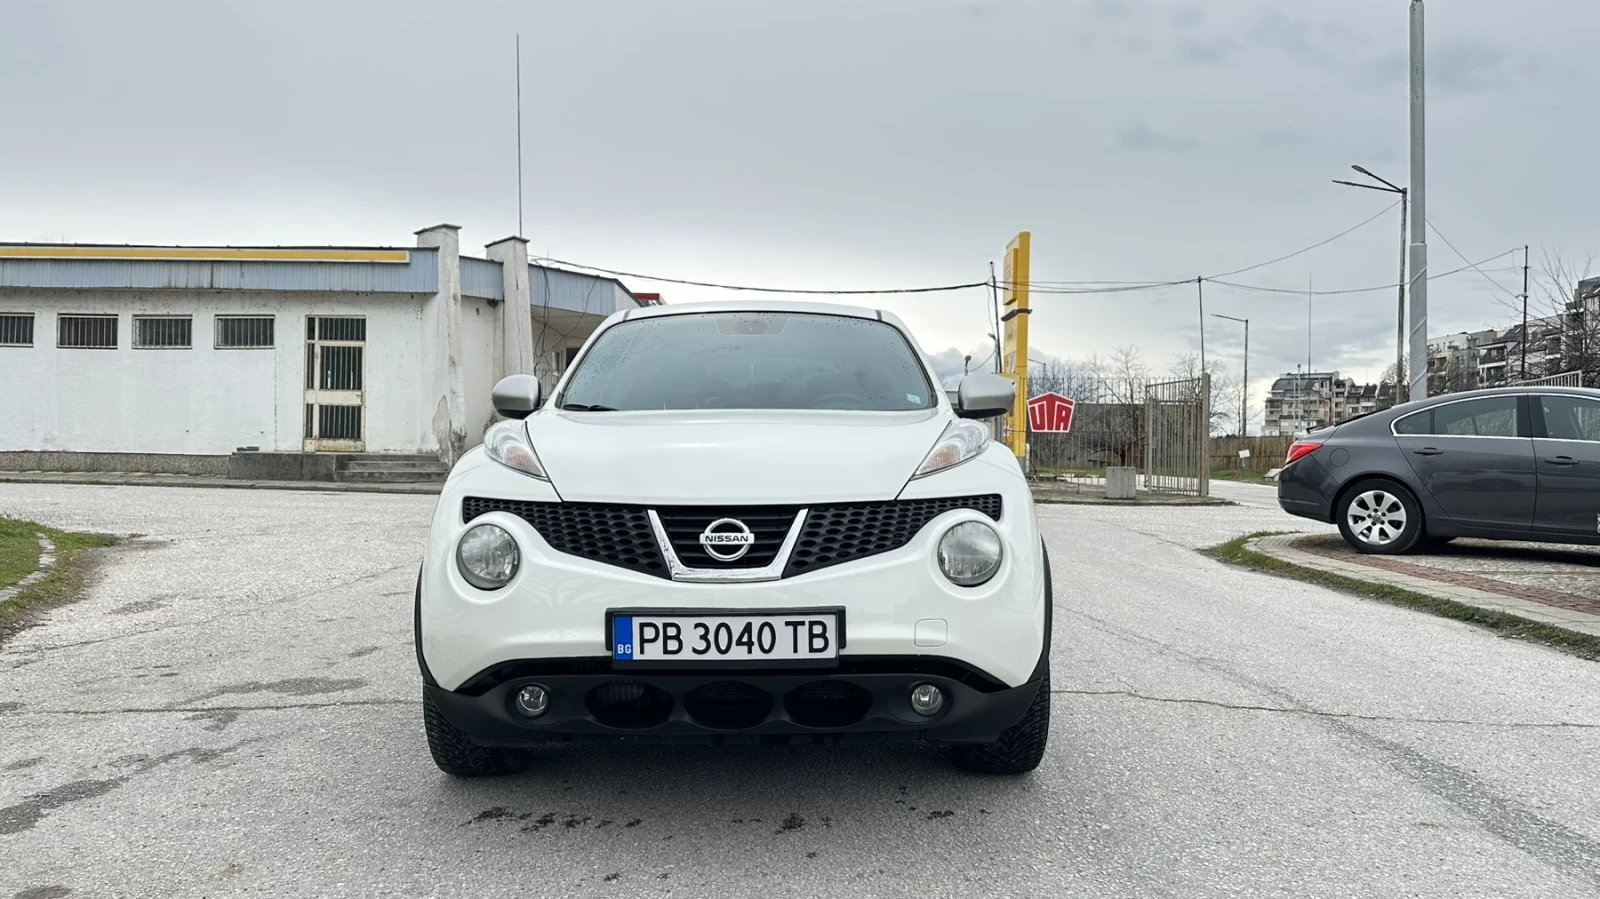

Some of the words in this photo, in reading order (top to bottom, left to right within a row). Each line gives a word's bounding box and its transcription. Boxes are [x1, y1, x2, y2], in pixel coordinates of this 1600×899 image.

[1027, 392, 1075, 432] UTA
[705, 534, 749, 542] NISSAN
[638, 622, 684, 655] PB
[691, 621, 777, 655] 3040
[784, 620, 830, 654] TB
[617, 644, 632, 654] BG
